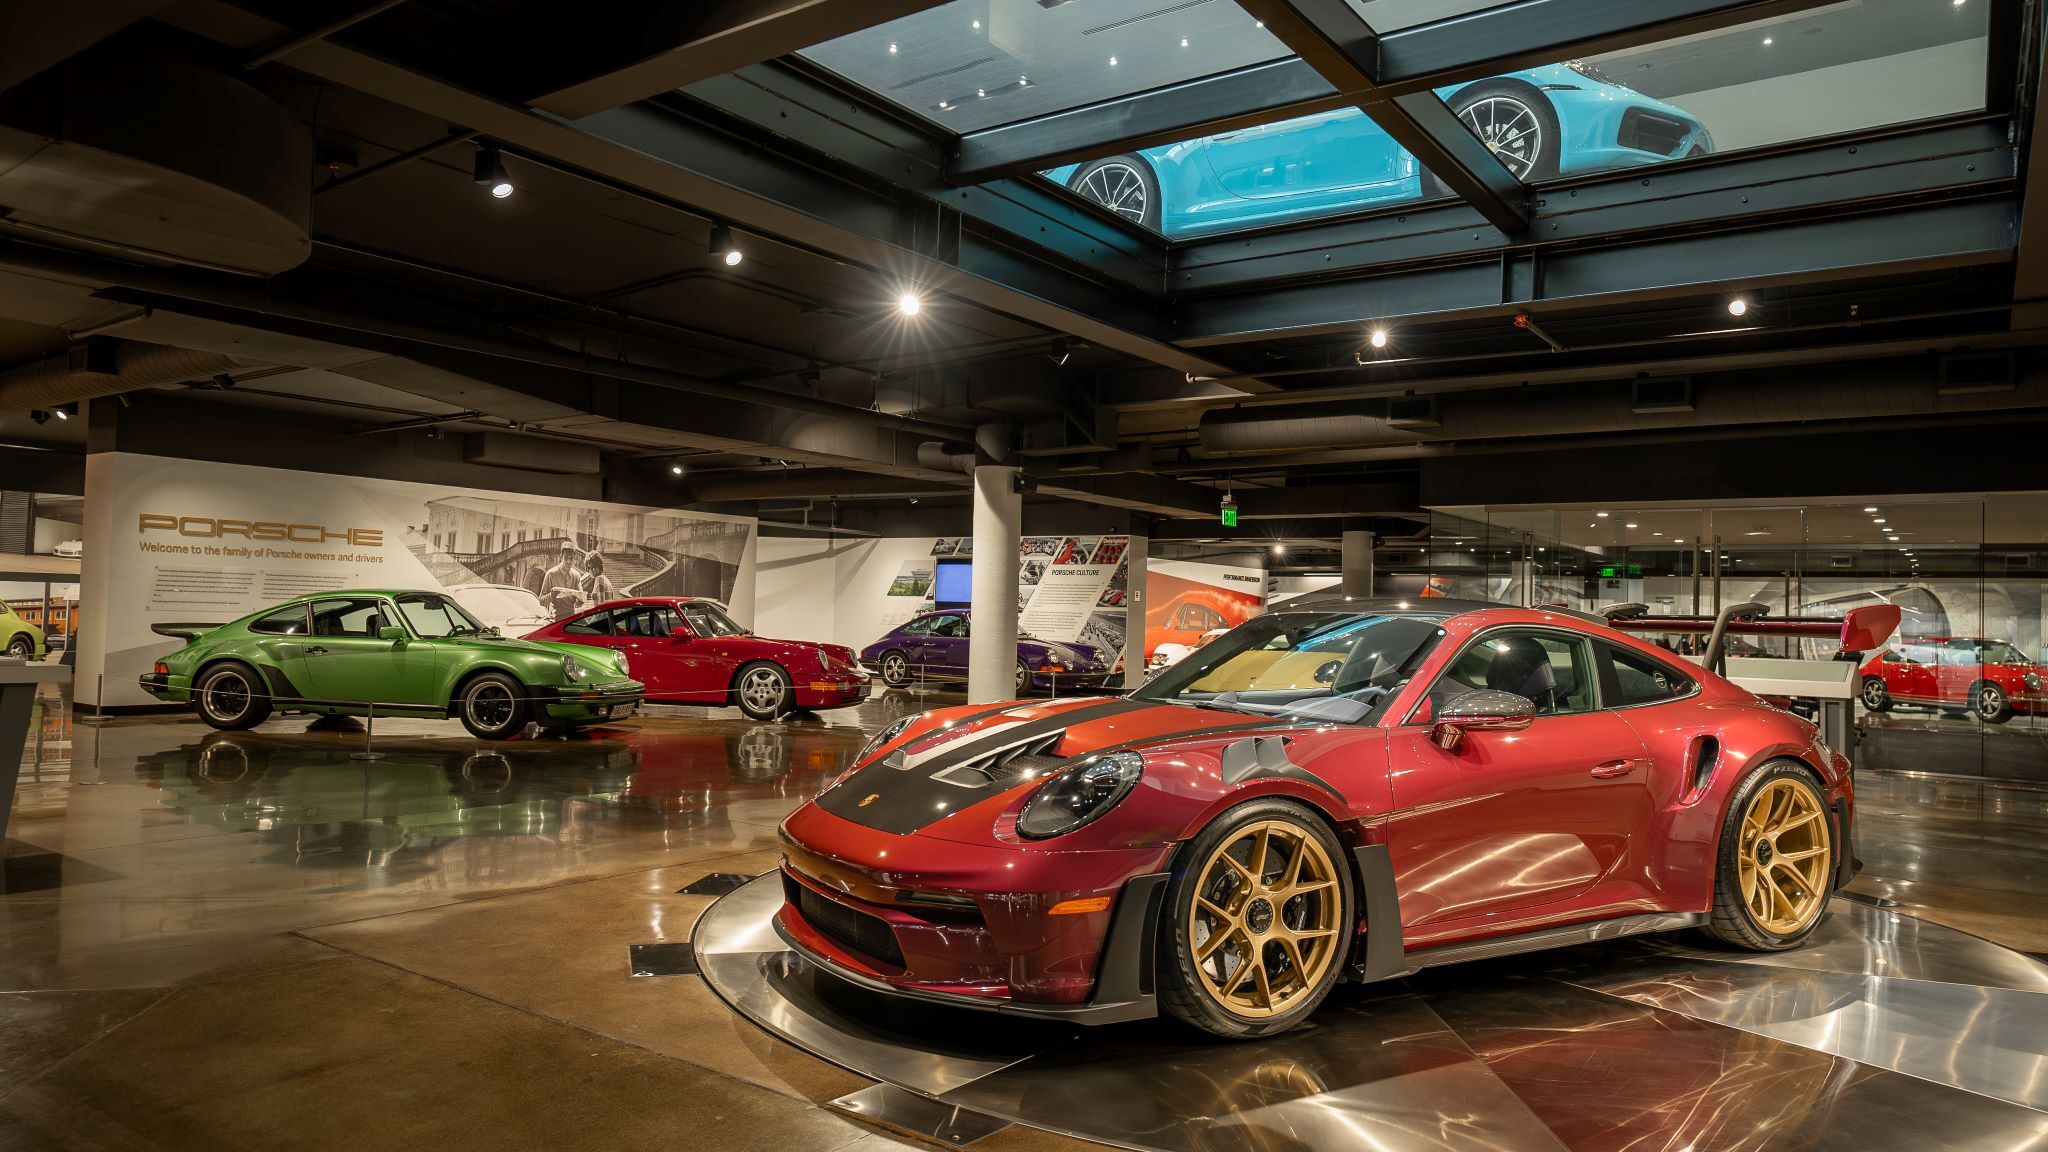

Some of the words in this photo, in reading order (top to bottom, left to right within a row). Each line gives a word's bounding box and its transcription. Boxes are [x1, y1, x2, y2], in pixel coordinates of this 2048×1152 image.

[138, 513, 383, 547] PORSCHE
[140, 541, 188, 554] Welcome
[191, 545, 202, 555] to
[204, 545, 221, 556] the
[222, 546, 252, 559] family
[254, 548, 265, 558] of
[266, 548, 302, 560] Porsche
[304, 552, 335, 561] owners
[338, 553, 354, 562] and
[355, 554, 383, 564] drivers
